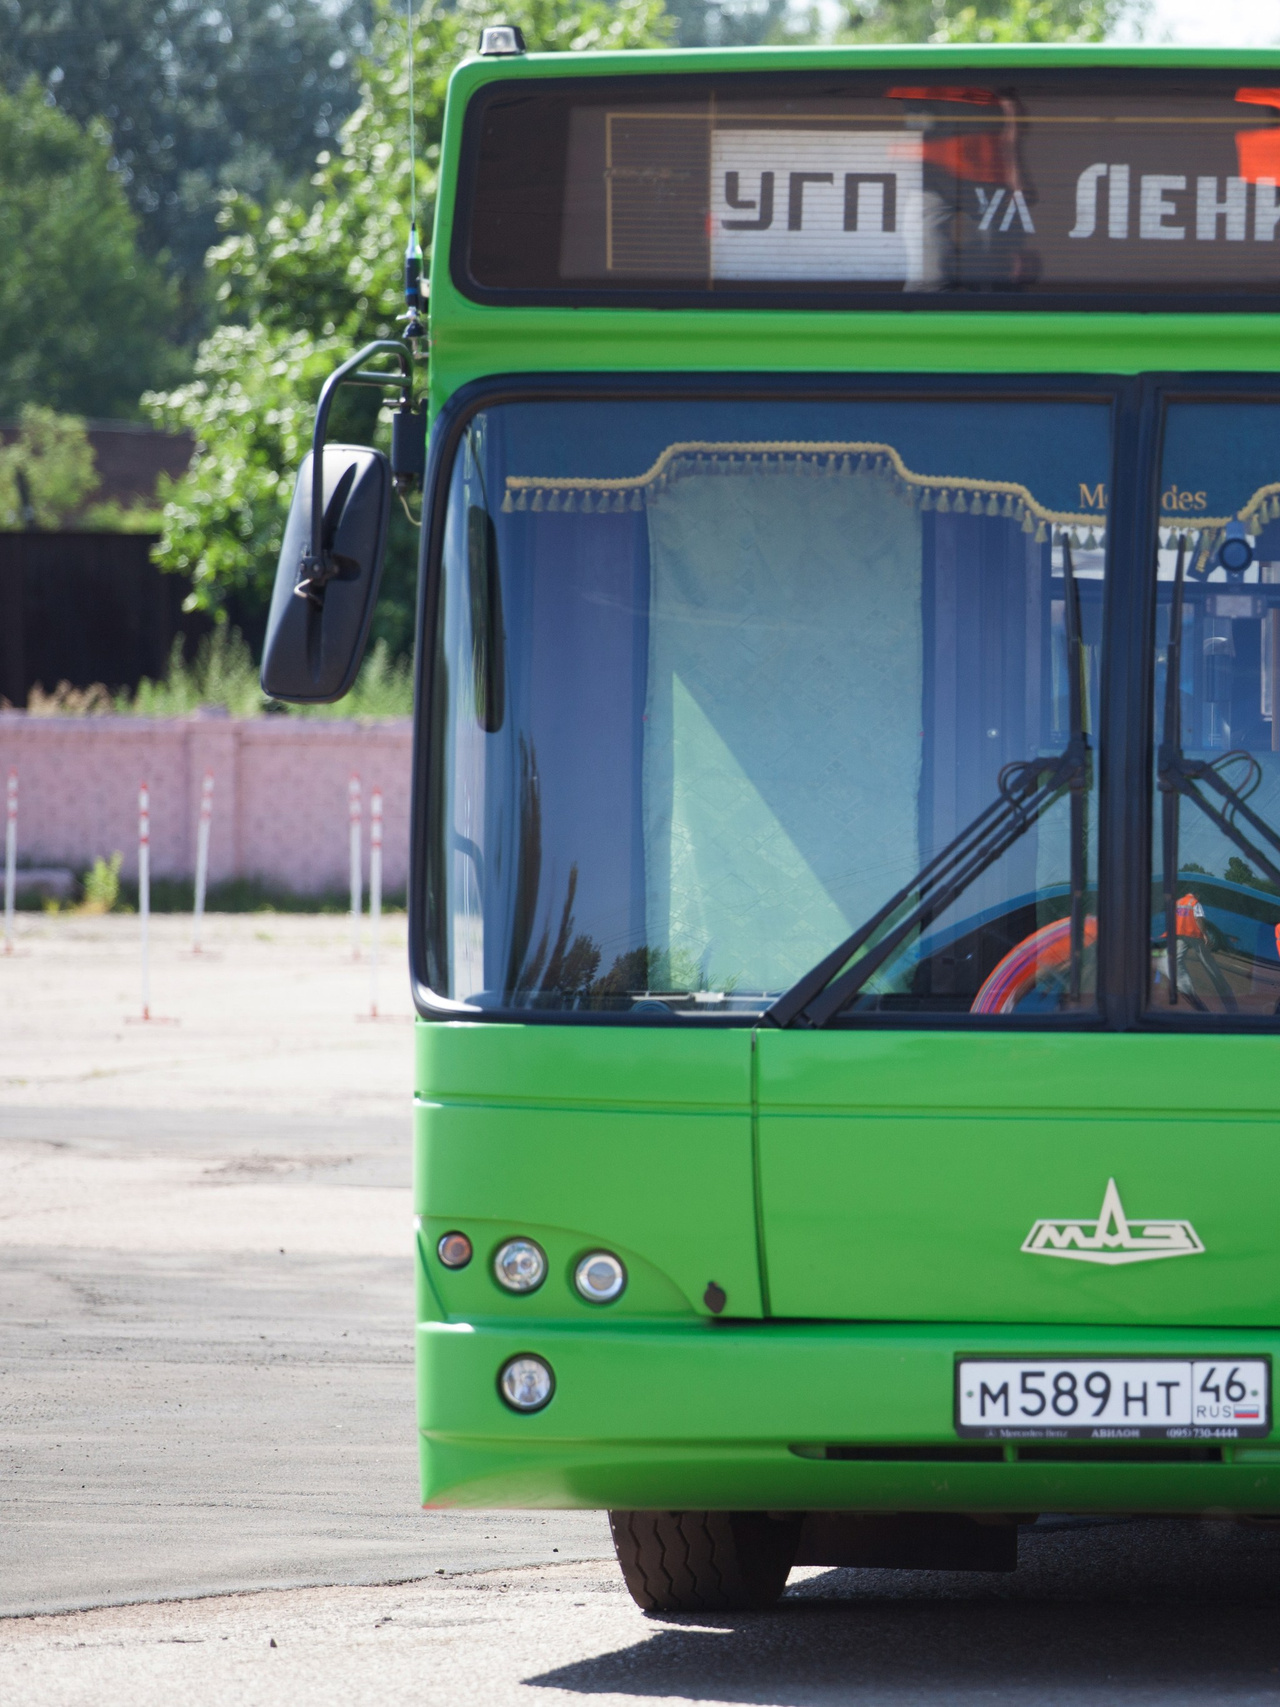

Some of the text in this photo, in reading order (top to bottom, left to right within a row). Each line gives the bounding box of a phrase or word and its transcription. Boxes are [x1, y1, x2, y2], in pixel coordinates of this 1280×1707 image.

[720, 170, 897, 233] УГП
[1078, 482, 1208, 512] Mdes
[979, 1366, 1247, 1417] М589НТ 46
[1196, 1404, 1232, 1418] RUS
